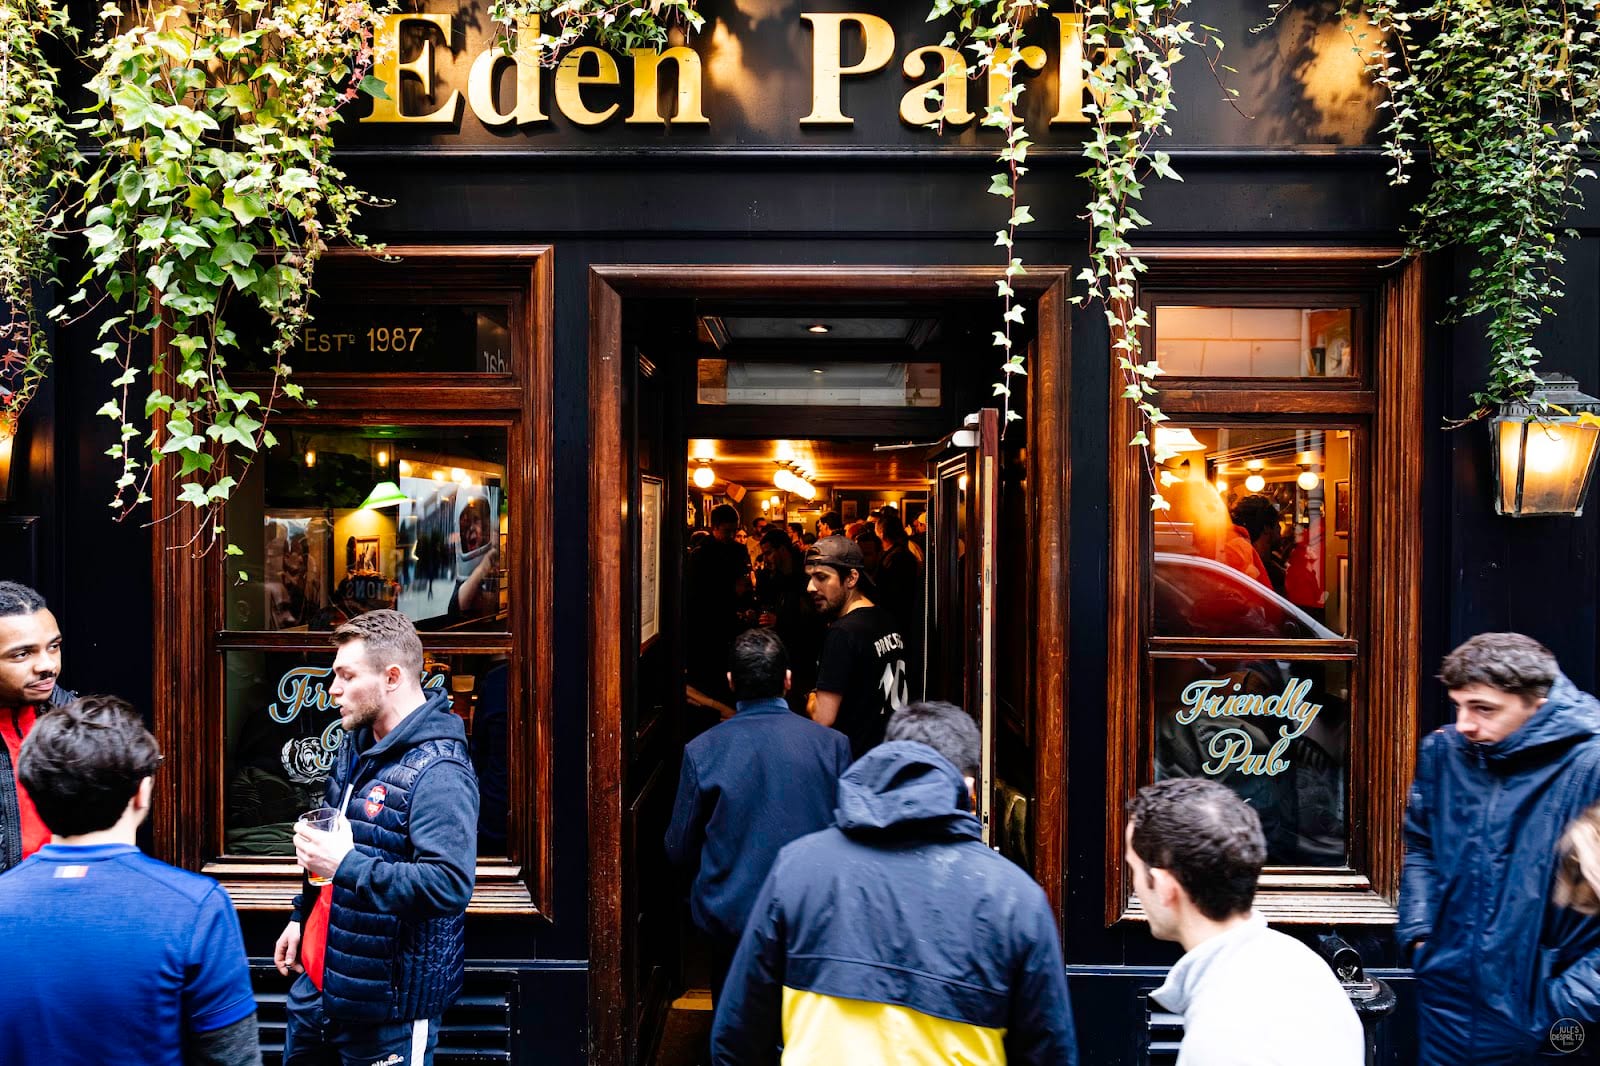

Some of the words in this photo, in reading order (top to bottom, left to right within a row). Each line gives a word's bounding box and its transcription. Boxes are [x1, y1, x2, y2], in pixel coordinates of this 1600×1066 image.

[360, 13, 710, 126] Eden
[366, 327, 422, 351] 1987
[1175, 677, 1323, 739] Friendly
[1202, 728, 1290, 776] Pub
